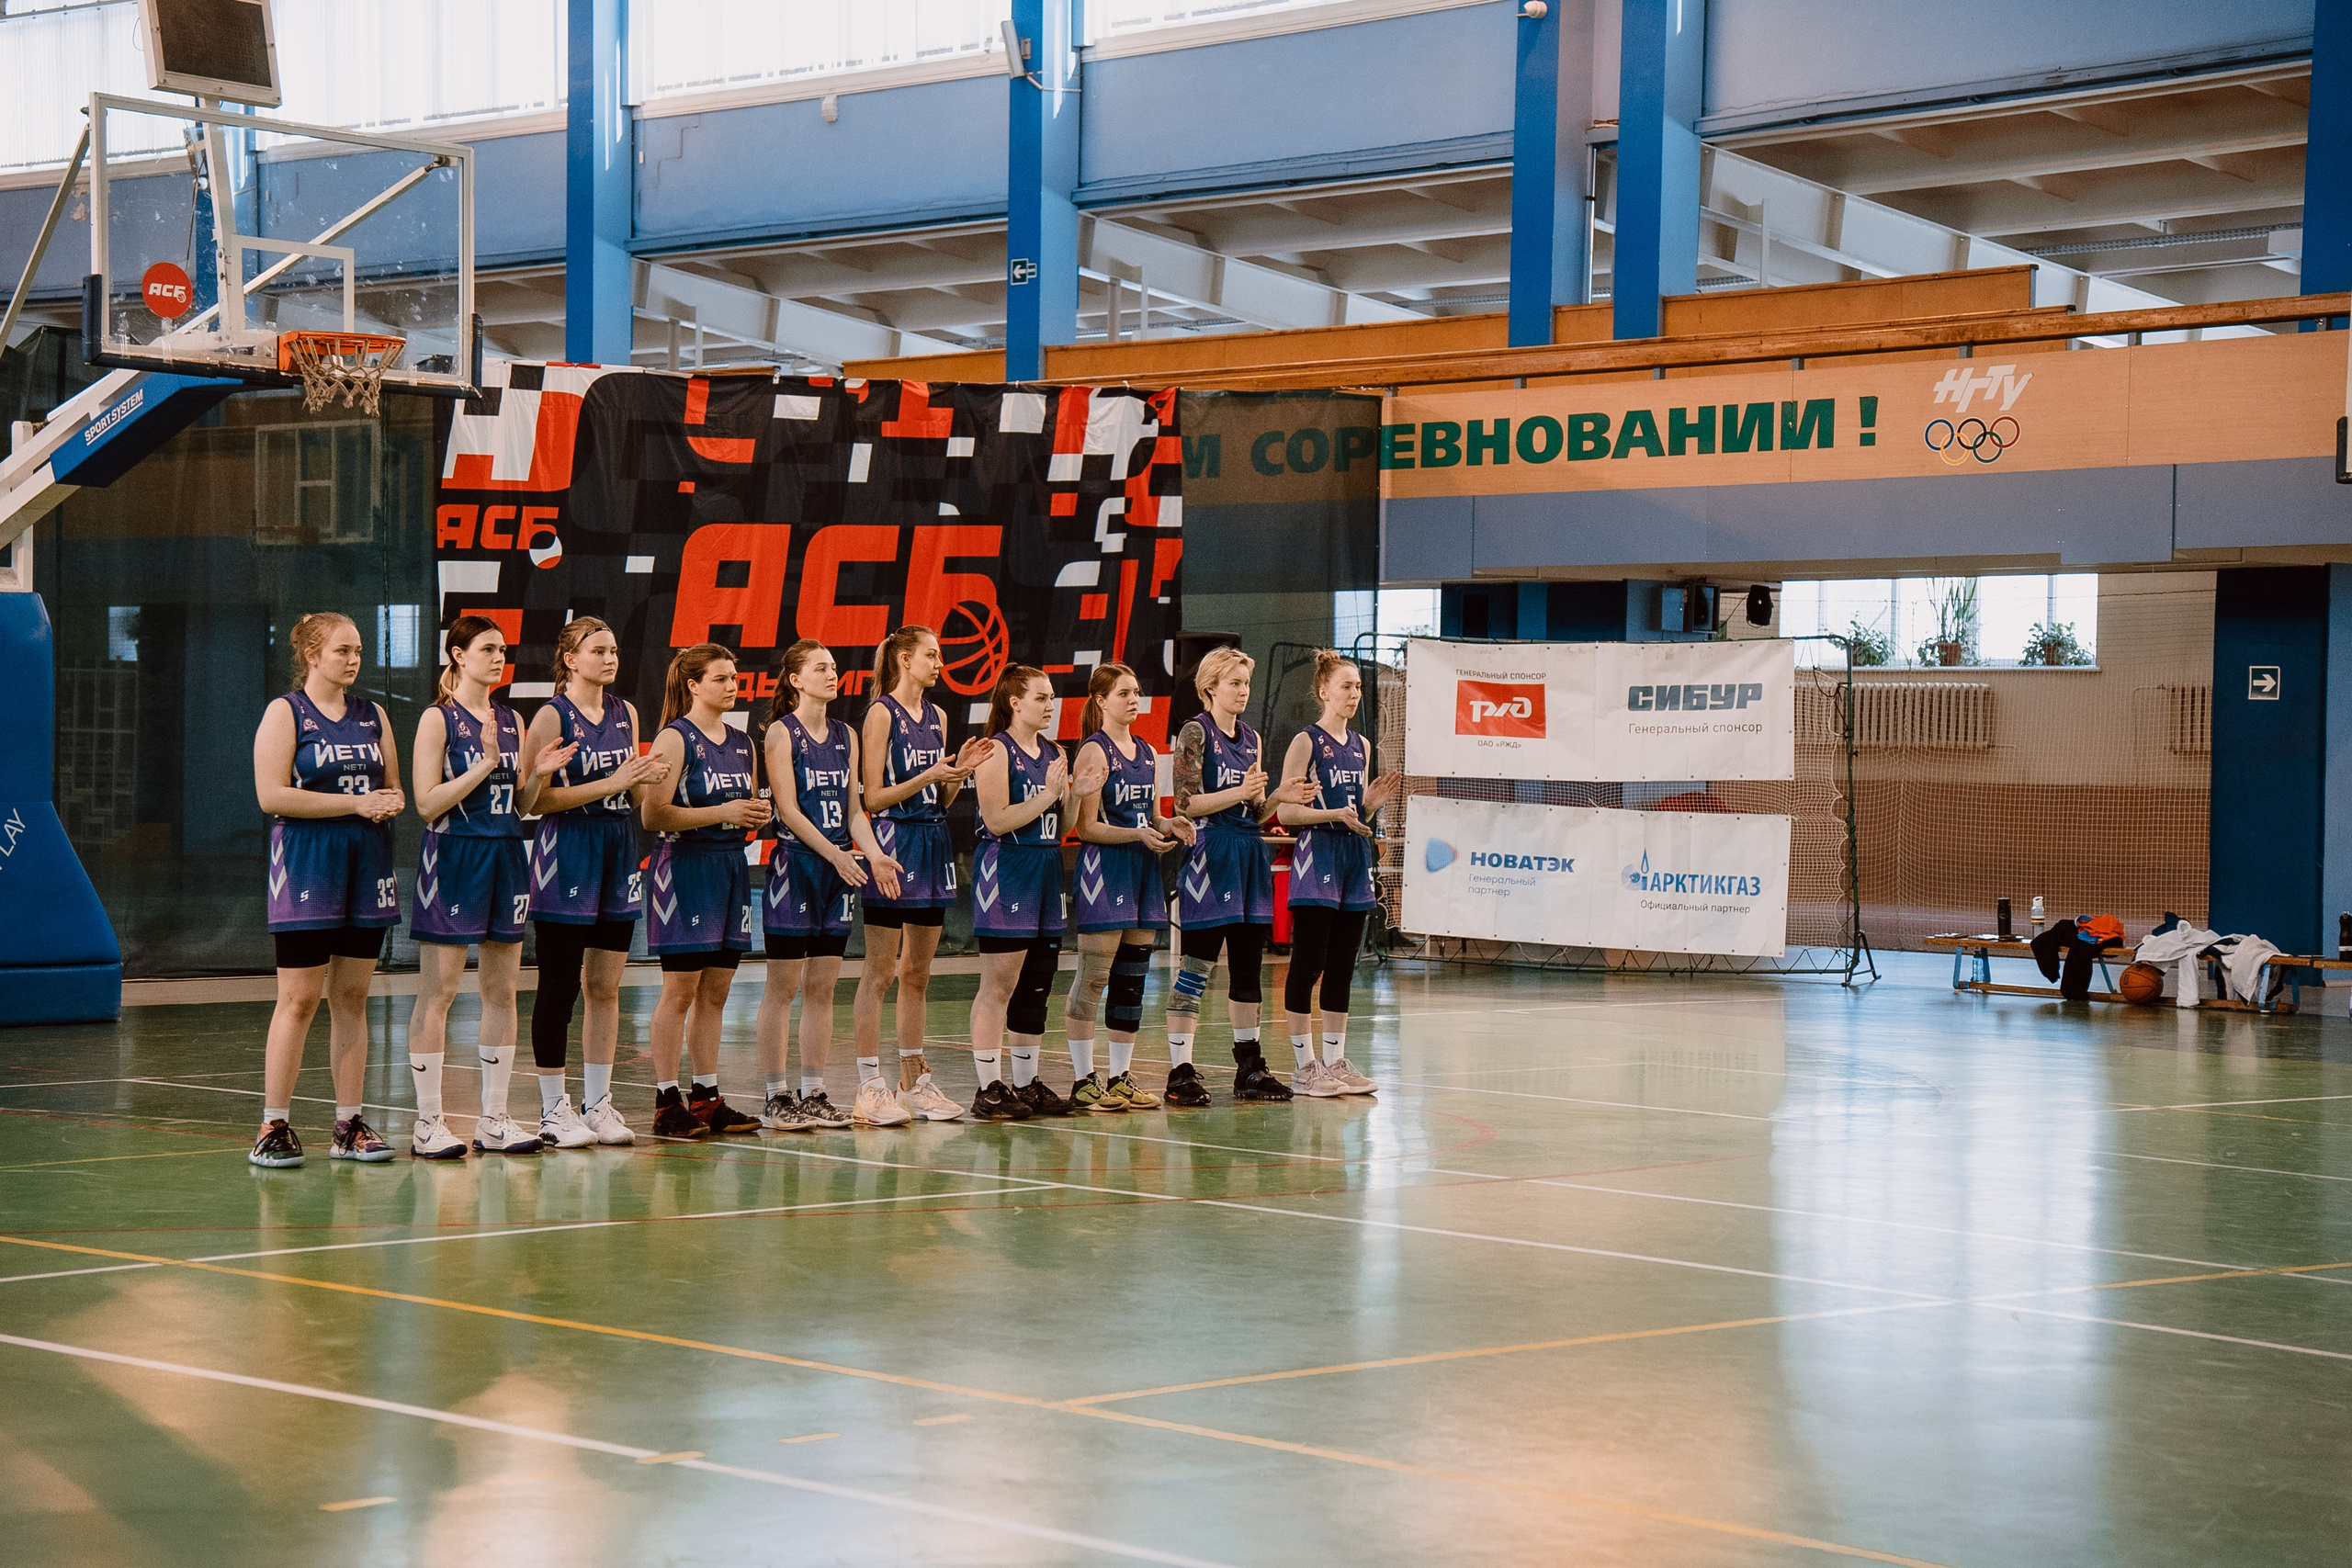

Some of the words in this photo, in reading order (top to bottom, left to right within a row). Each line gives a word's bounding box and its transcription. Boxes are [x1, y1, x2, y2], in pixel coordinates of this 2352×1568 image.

[85, 412, 111, 442] SPORT
[111, 388, 143, 421] SYSTEM
[670, 523, 1009, 695] АСБ
[1455, 669, 1508, 680] ГЕНЕРАЛЬНЫЙ
[1627, 682, 1763, 711] СИБУР
[1629, 722, 1709, 736] Генеральный
[1713, 723, 1763, 735] спонсор
[1477, 739, 1494, 748] ОАО
[490, 784, 514, 815] 27
[820, 800, 842, 829] 13
[1040, 813, 1057, 840] 10
[1470, 851, 1576, 874] НОВАТЭК
[377, 877, 395, 908] 33
[1467, 886, 1511, 897] партнер
[1468, 873, 1536, 886] Генеральный
[1649, 872, 1761, 897] АРКТИКГАЗ
[514, 894, 530, 924] 27
[1640, 899, 1709, 911] Официальный
[1711, 903, 1751, 915] партнер
